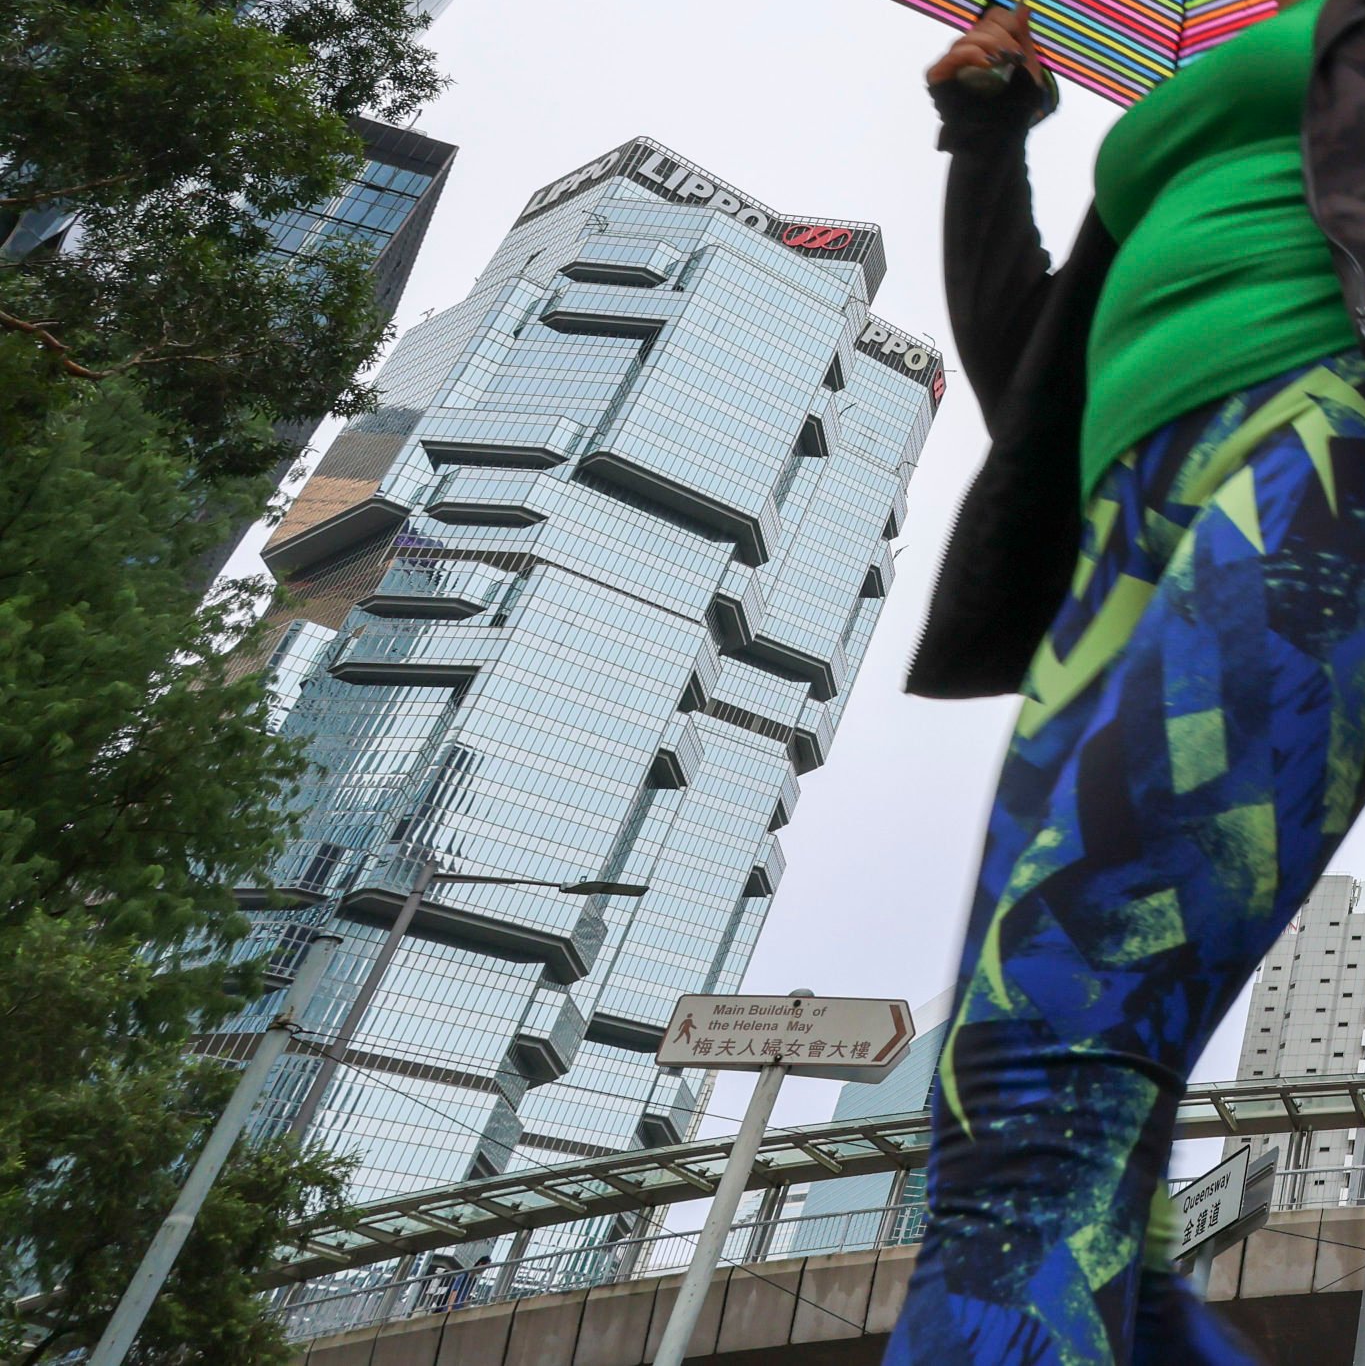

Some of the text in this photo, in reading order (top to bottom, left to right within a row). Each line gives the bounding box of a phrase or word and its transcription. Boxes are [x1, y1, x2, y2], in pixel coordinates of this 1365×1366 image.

[522, 151, 620, 217] LIPPO
[637, 151, 768, 233] LIPPO
[860, 320, 929, 371] PPO
[708, 1020, 813, 1034] the Helena May
[713, 1005, 828, 1018] Main Building of
[692, 1038, 871, 1059] 梅夫人婦女會大樓
[1183, 1172, 1231, 1213] Queensway
[1182, 1199, 1221, 1245] 金鐘道
